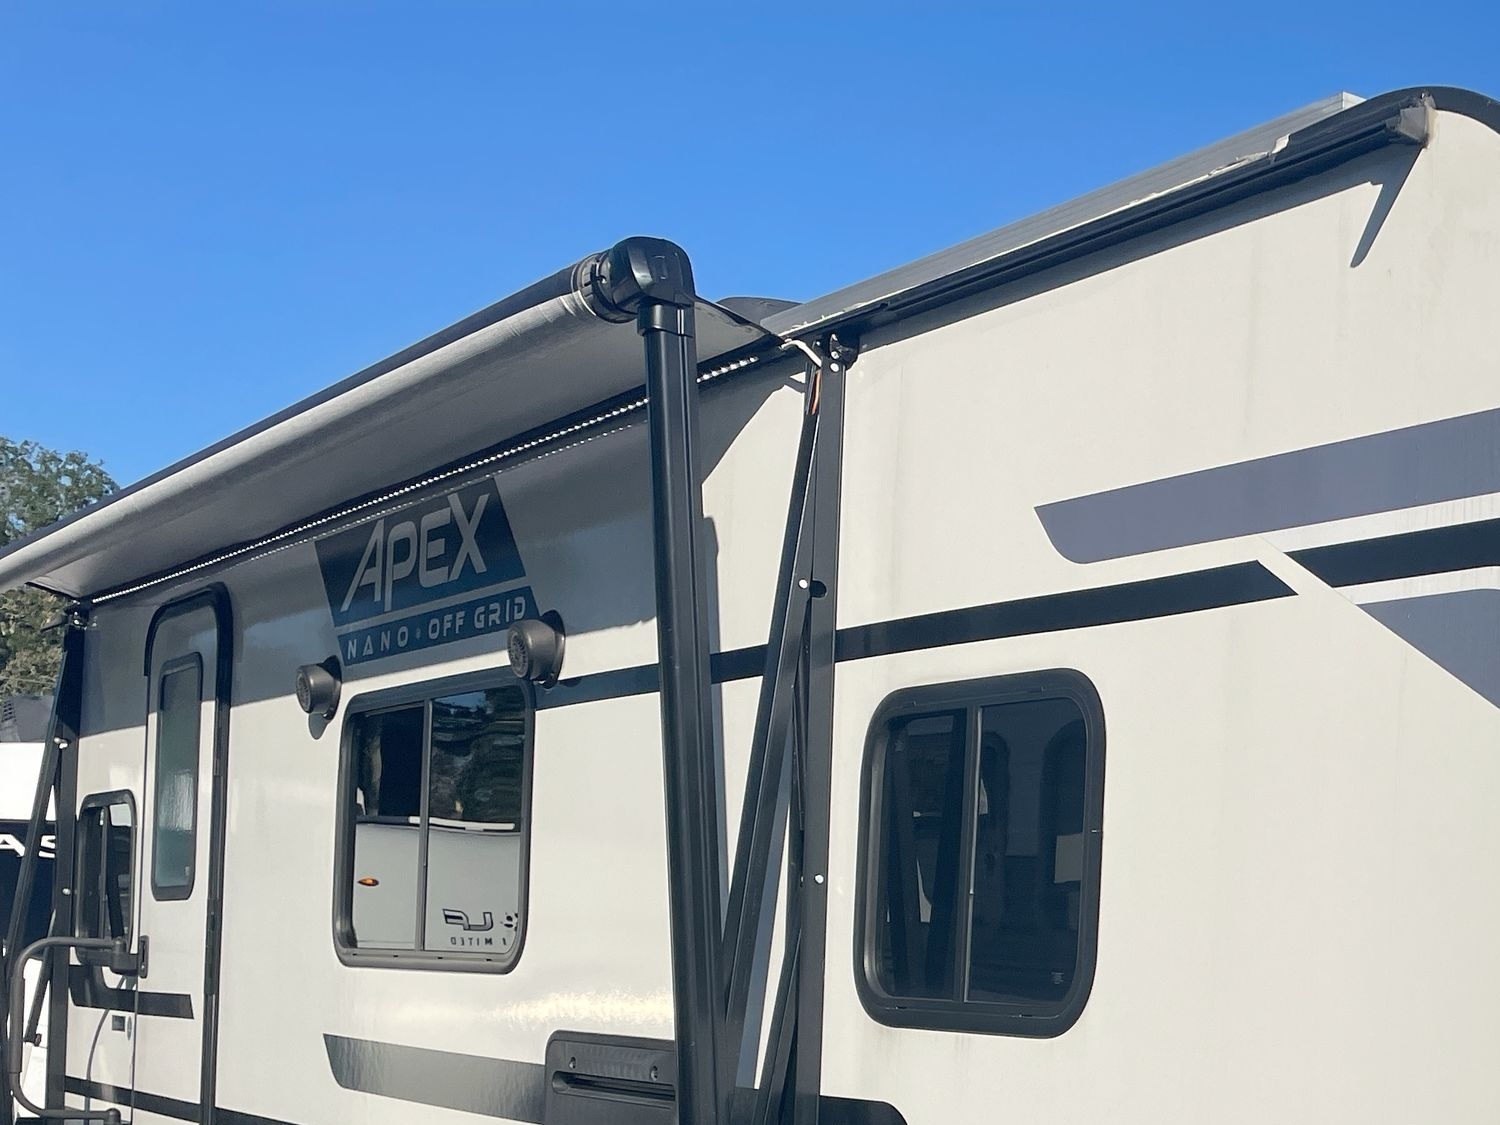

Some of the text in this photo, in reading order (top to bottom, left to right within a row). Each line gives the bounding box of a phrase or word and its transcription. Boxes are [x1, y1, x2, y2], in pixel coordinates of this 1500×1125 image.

[340, 492, 490, 612] APEX
[347, 596, 526, 660] NANO OFF GRID
